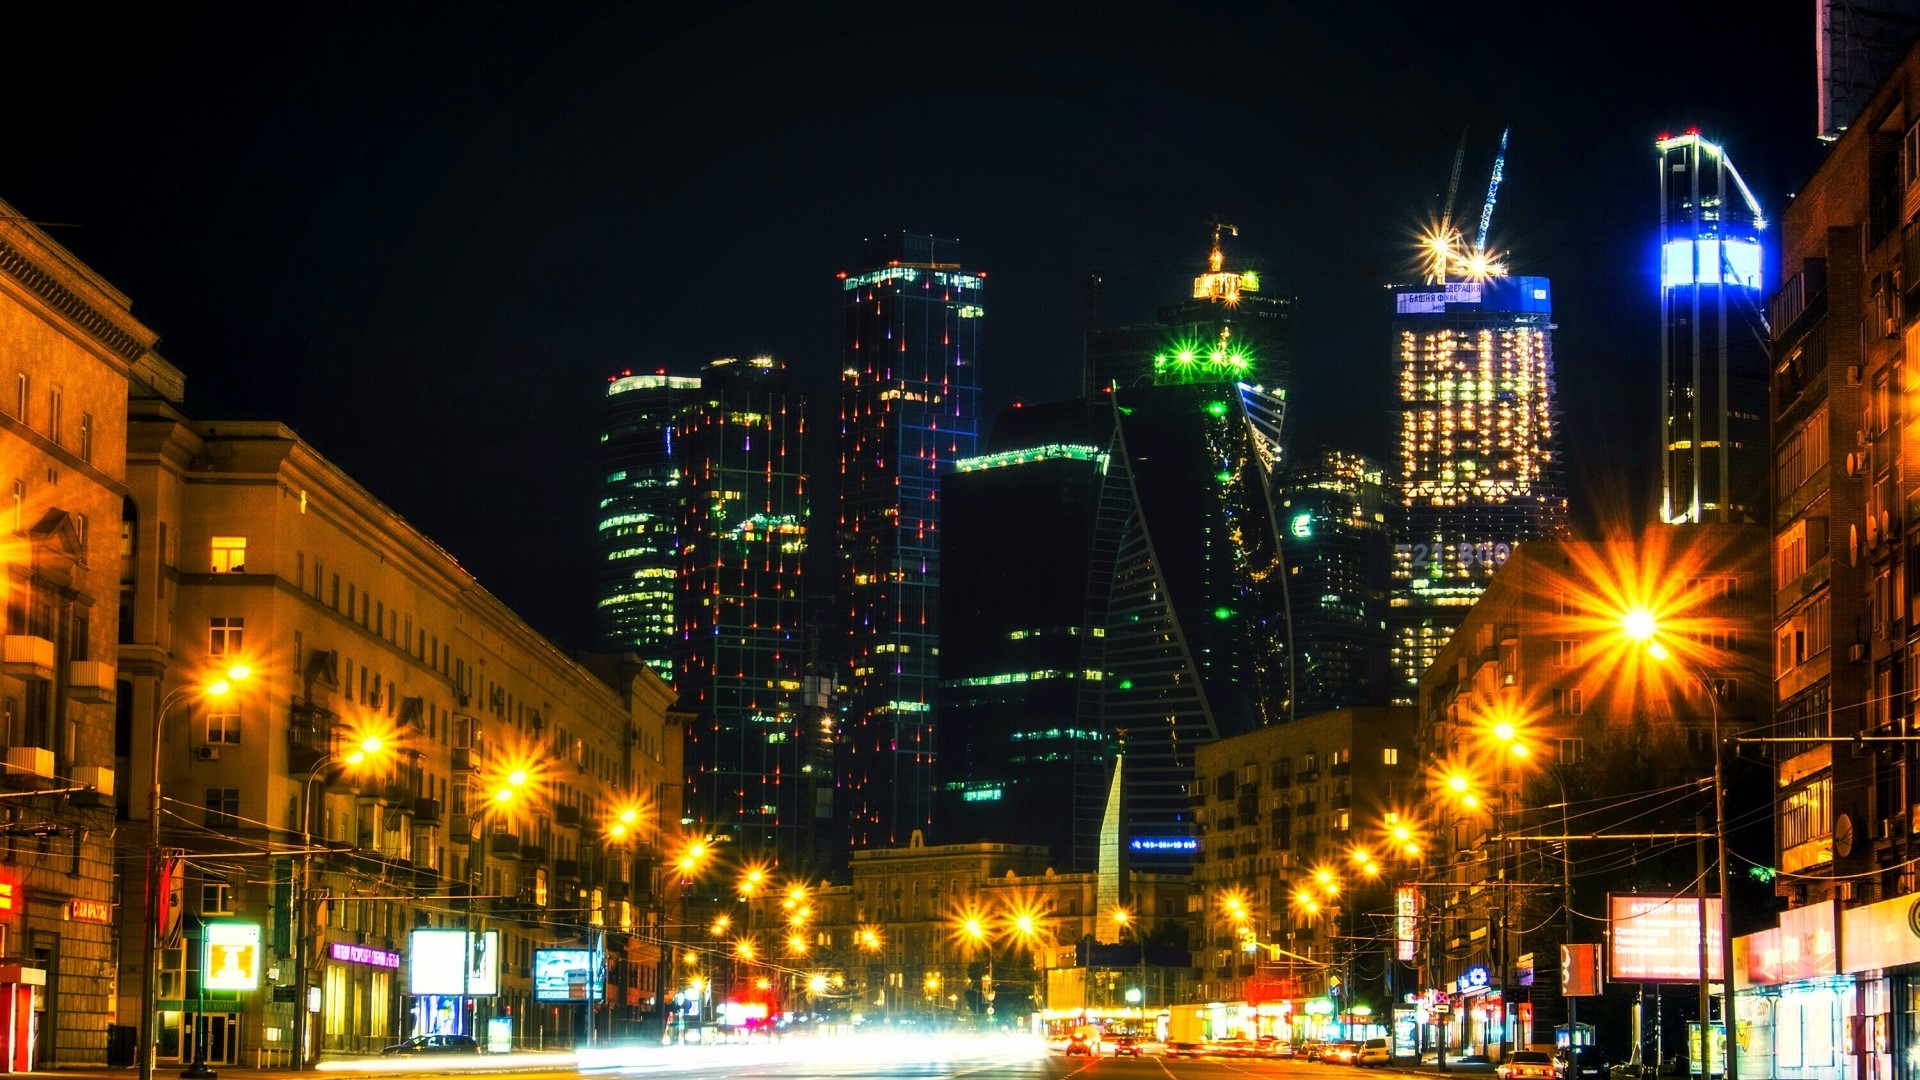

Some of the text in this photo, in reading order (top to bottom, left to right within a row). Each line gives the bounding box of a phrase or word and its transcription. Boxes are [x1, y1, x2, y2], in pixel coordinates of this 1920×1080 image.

[1409, 294, 1435, 303] БАШНЯ
[1394, 542, 1510, 567] 721 800
